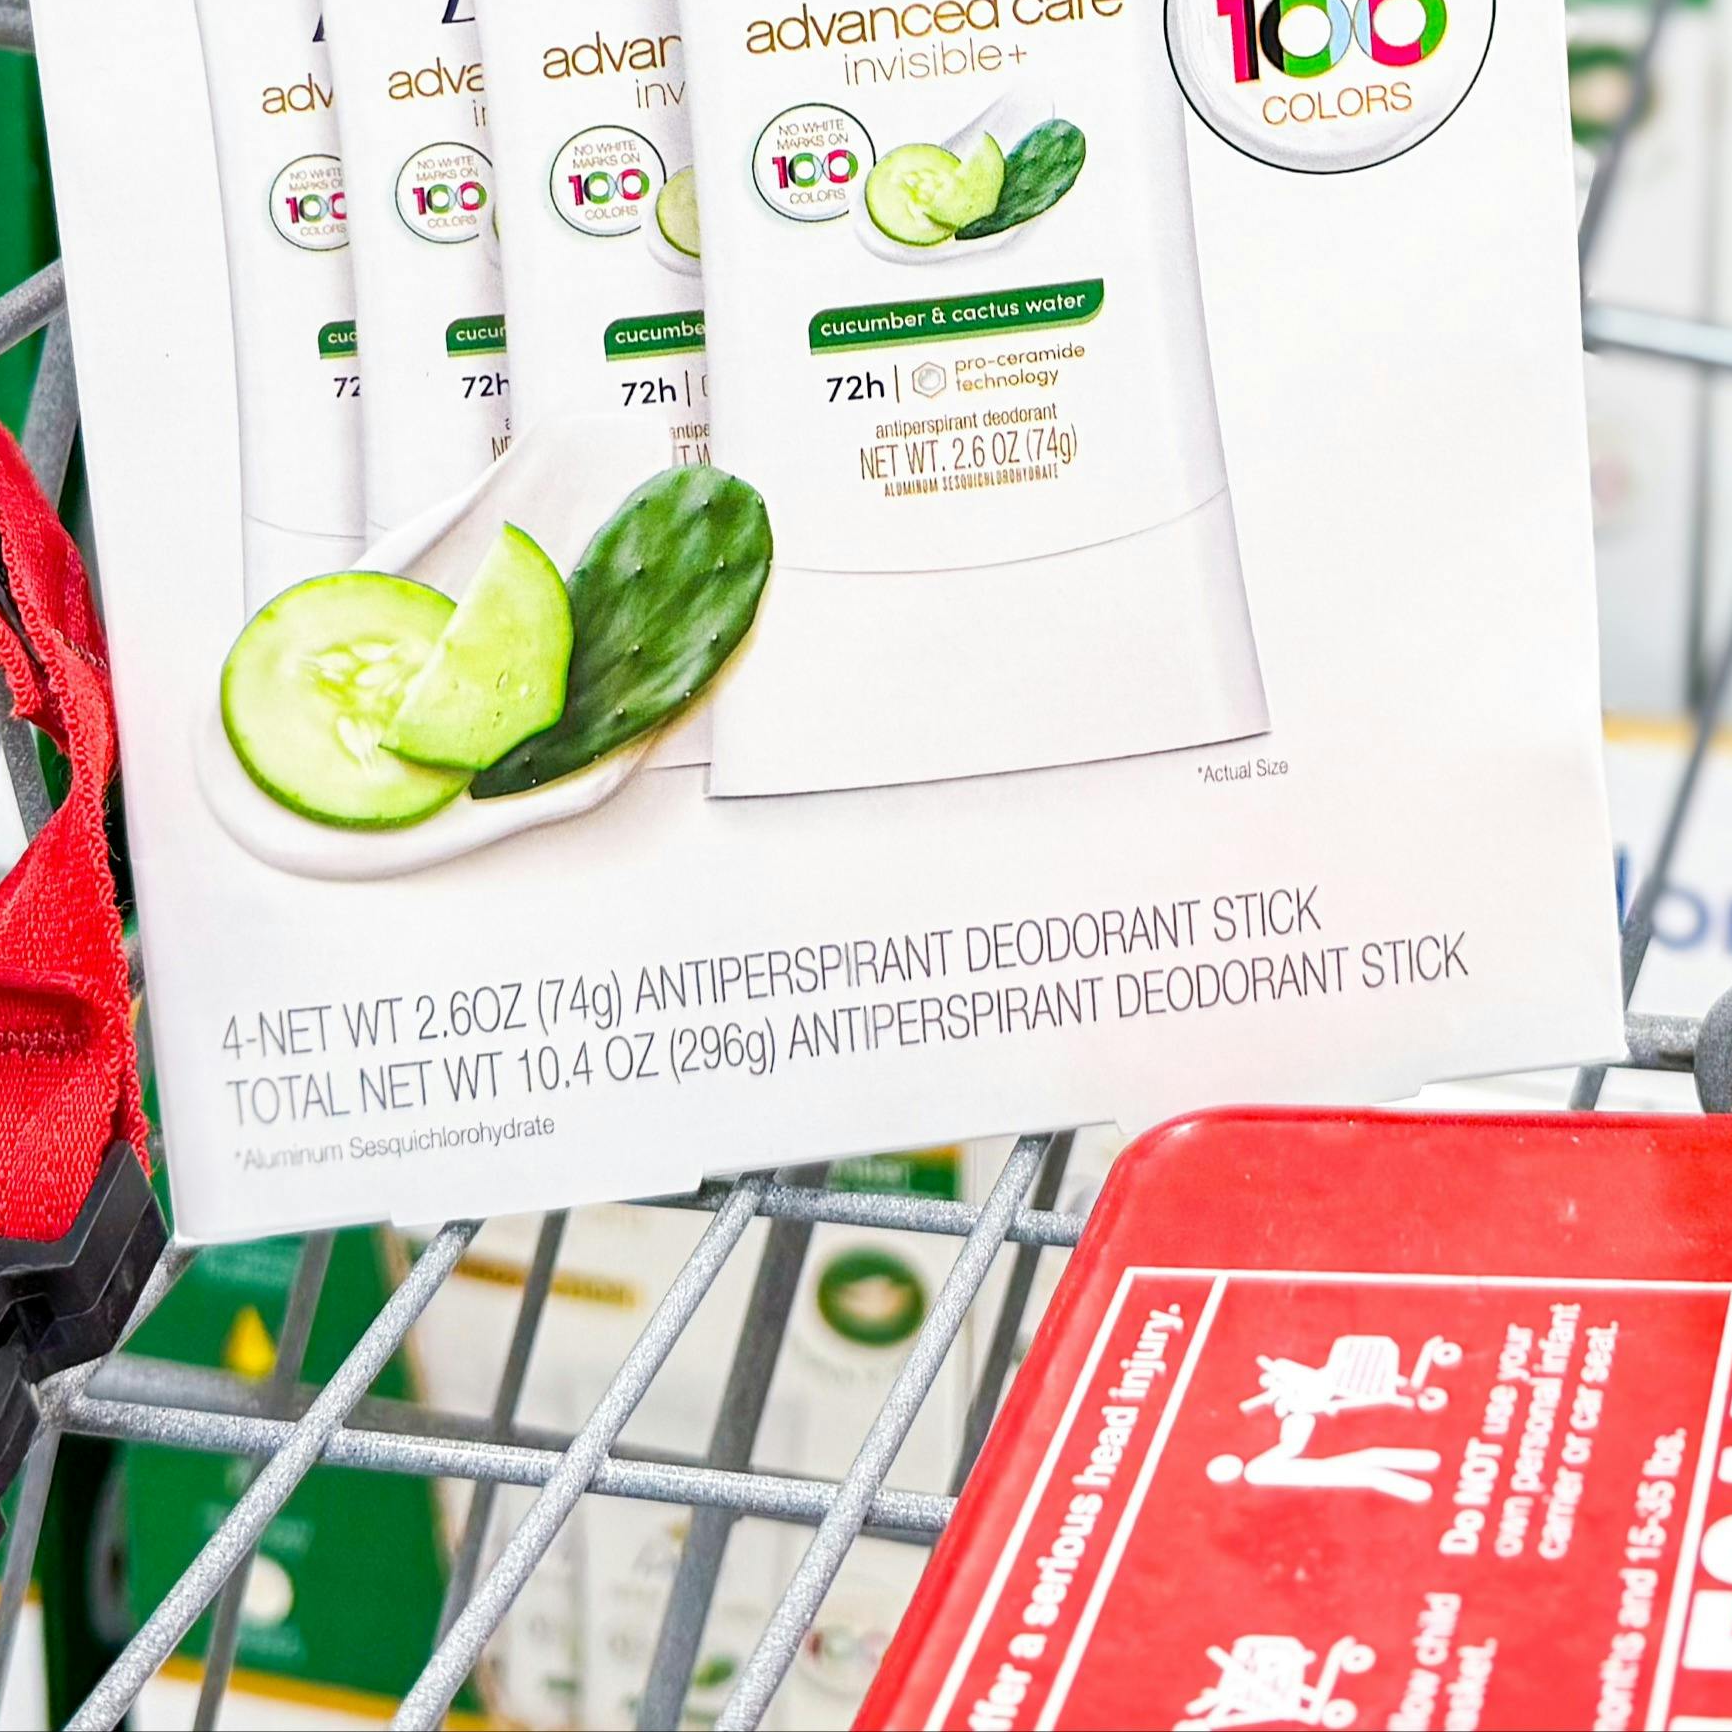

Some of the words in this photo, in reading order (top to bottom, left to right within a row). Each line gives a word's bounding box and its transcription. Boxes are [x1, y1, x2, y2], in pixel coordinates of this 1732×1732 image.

[844, 37, 1027, 85] invisible+
[1262, 83, 1412, 125] COLORS
[574, 145, 593, 157] NO
[596, 140, 636, 154] WHITE
[777, 135, 825, 150] MARKS
[828, 133, 848, 146] ON
[778, 124, 799, 136] NO
[803, 119, 845, 133] WHITE
[417, 159, 435, 170] NO
[438, 155, 474, 168] WHITE
[460, 167, 479, 179] ON
[573, 154, 618, 169] MARKS
[621, 152, 641, 165] ON
[772, 149, 858, 189] 100
[412, 181, 487, 215] 100
[568, 168, 650, 206] 100
[790, 188, 846, 205] COLORS
[585, 205, 638, 221] COLORS
[820, 310, 925, 337] cucumber
[931, 307, 947, 325] &
[952, 301, 1020, 323] cactus
[1025, 292, 1086, 313] water
[955, 344, 1086, 374] pro-ceramide
[956, 369, 1060, 394] technology
[622, 377, 677, 407] 72h
[826, 371, 885, 403] 72h
[875, 413, 978, 439] antiperspirant
[983, 403, 1058, 427] deodorant
[860, 445, 898, 480] NET
[905, 439, 946, 475] WT.
[952, 435, 985, 470] 2.6
[991, 430, 1020, 465] OZ
[1026, 423, 1078, 465] (74g)
[1256, 758, 1289, 778] Size
[221, 1007, 332, 1060] 4-NET
[340, 997, 403, 1048] WT
[538, 971, 623, 1035] (74g)
[634, 928, 954, 1014] ANTIPERSPIRANT
[967, 900, 1201, 972] DEODORANT
[1213, 885, 1321, 944] STICK
[225, 1073, 350, 1126] TOTAL
[360, 1059, 434, 1113] NET
[443, 1051, 503, 1102] WT
[517, 1039, 594, 1094] 10.4
[605, 1032, 659, 1081] OZ
[668, 1018, 776, 1084] (296g)
[788, 974, 1105, 1061] ANTIPERSPIRANT
[1117, 948, 1350, 1019] DEODORANT
[1361, 930, 1470, 991] STICK
[349, 1115, 556, 1160] Sesquichlorohydrate
[1109, 1301, 1185, 1400] injury.
[1497, 1323, 1533, 1381] your
[1533, 1303, 1581, 1374] infant
[1482, 1384, 1518, 1435] use
[1570, 1385, 1603, 1431] car
[1071, 1406, 1139, 1488] head
[1511, 1378, 1564, 1492] personal
[1561, 1433, 1593, 1464] or
[1453, 1438, 1504, 1506] NOT
[1438, 1508, 1485, 1557] Do
[1495, 1497, 1533, 1558] own
[1538, 1466, 1584, 1560] carrier
[1626, 1480, 1676, 1562] 15-35
[1022, 1493, 1105, 1626] serious
[1617, 1567, 1659, 1629] and
[1009, 1632, 1048, 1661] a
[1411, 1591, 1462, 1666] child
